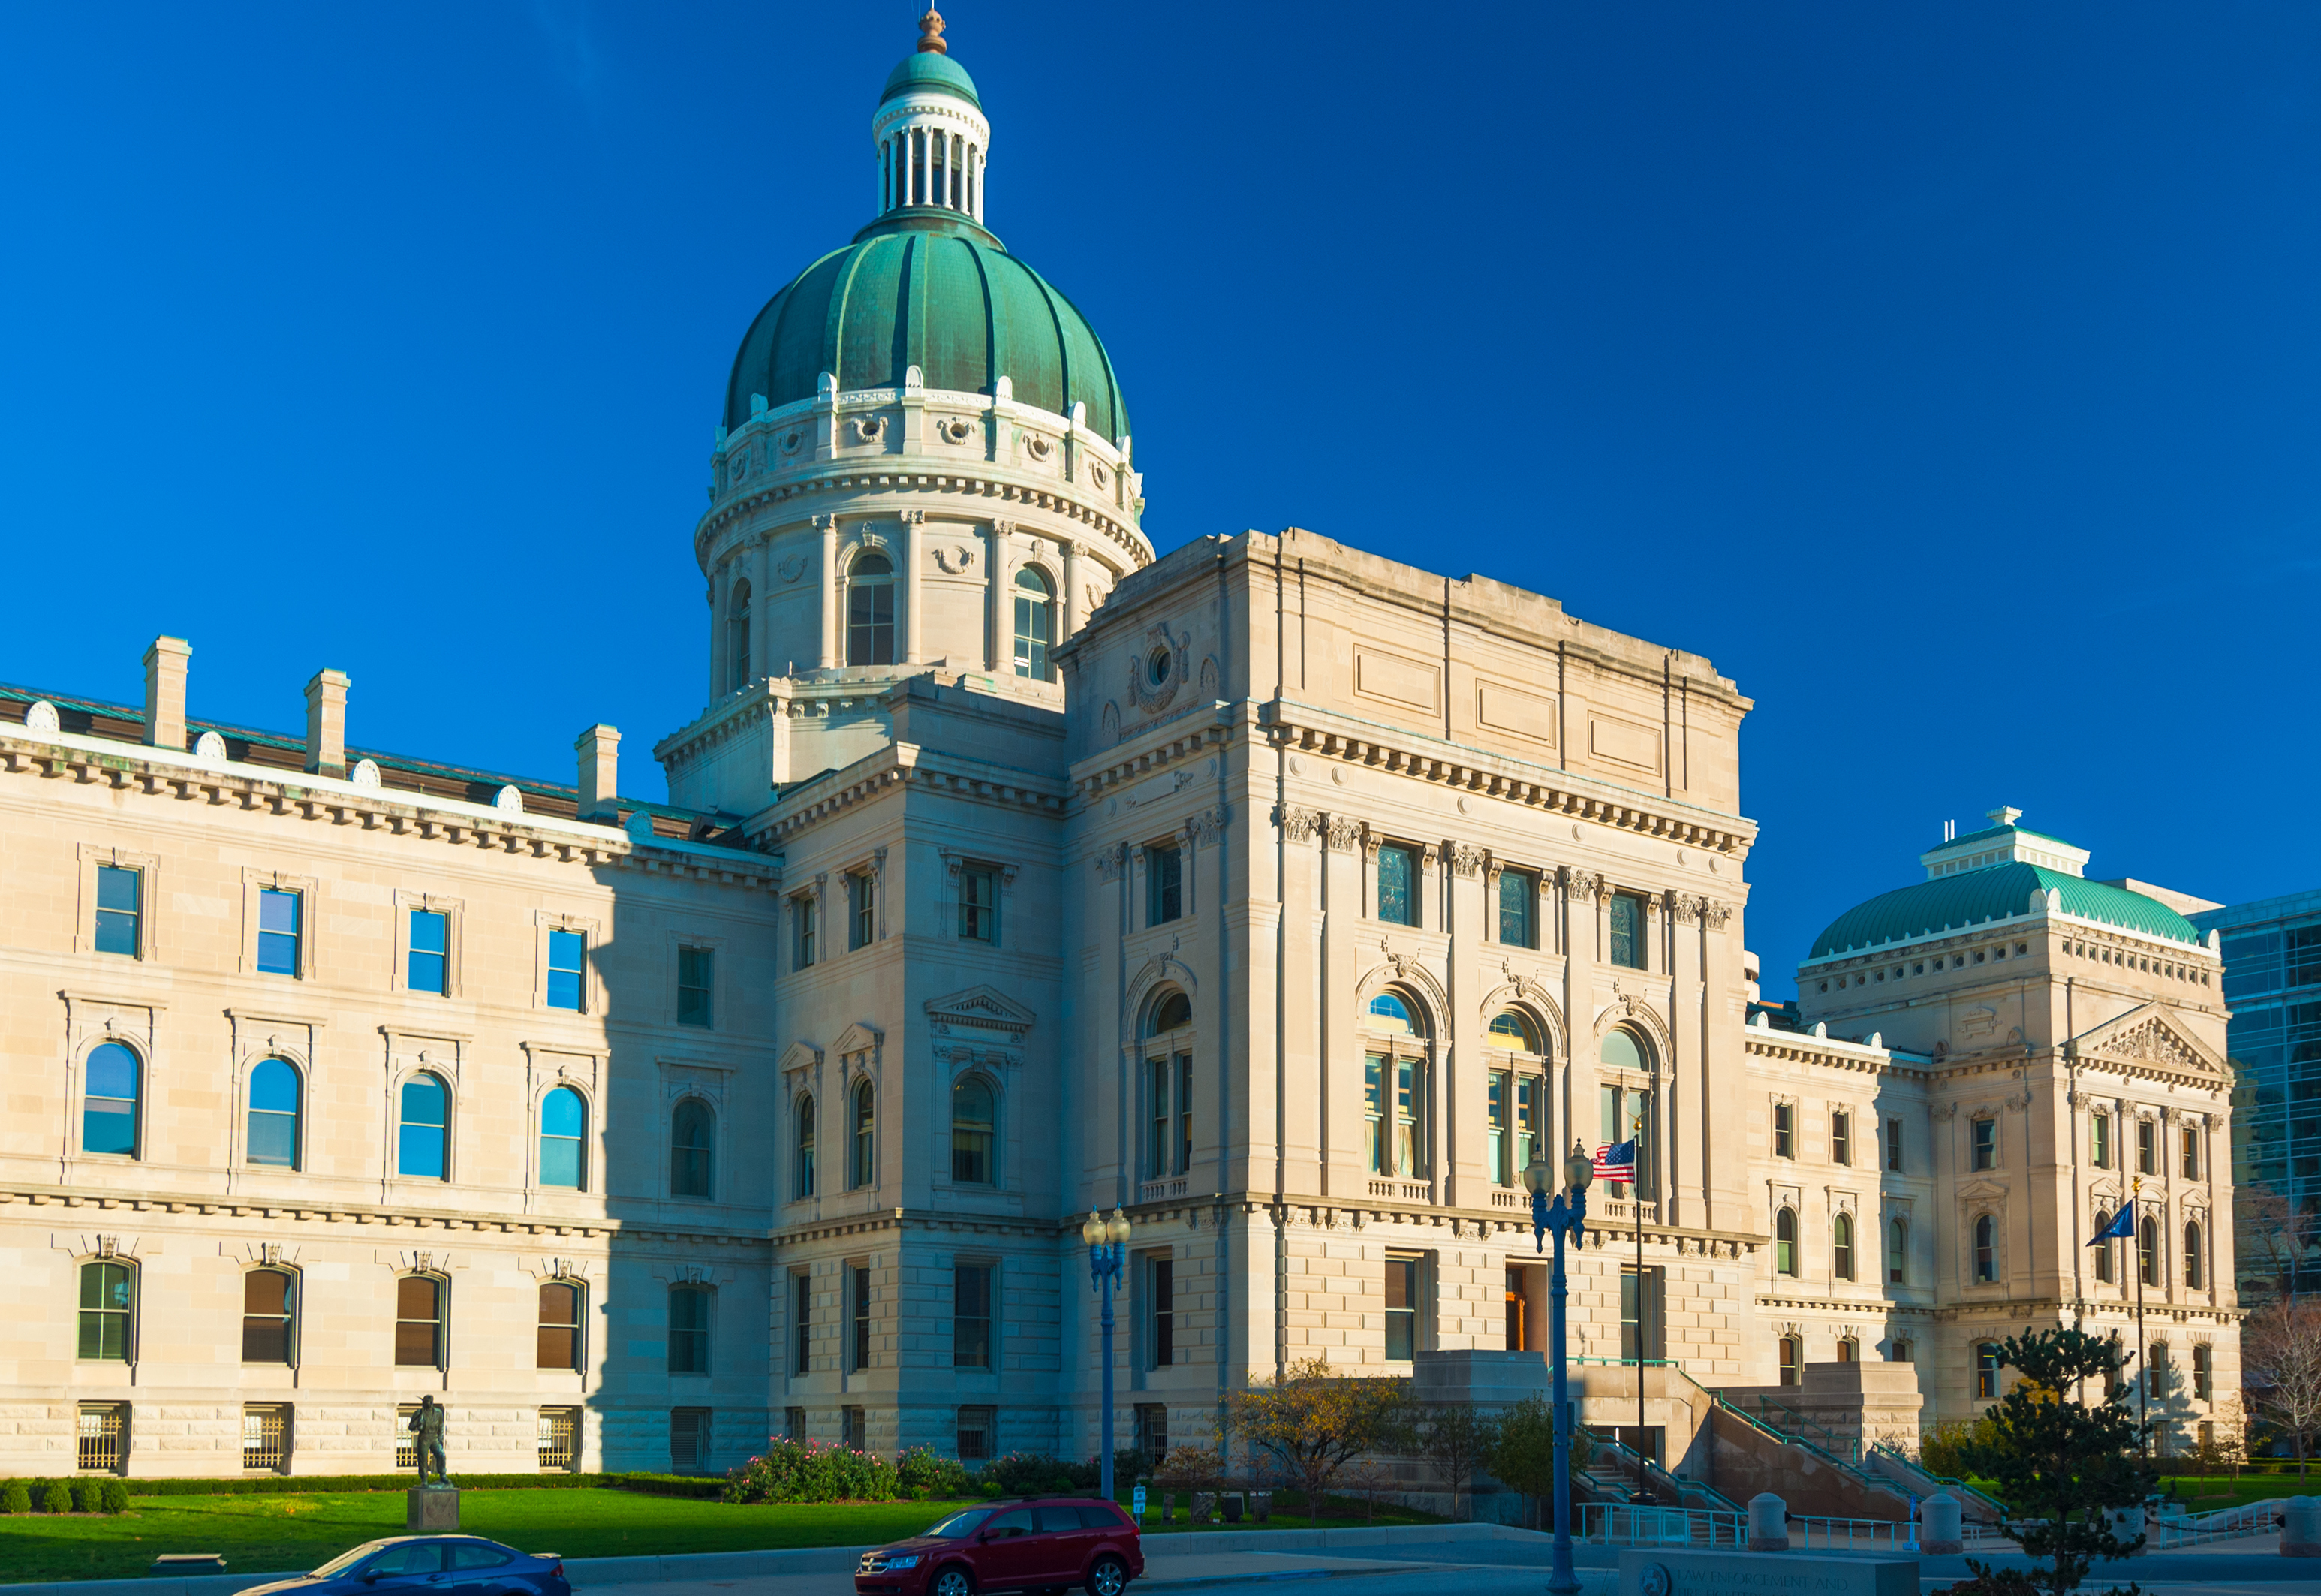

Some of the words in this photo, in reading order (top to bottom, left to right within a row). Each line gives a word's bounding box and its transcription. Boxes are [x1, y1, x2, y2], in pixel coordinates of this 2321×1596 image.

[1678, 1569, 1706, 1582] LAW
[1711, 1570, 1809, 1589] ENFORCEMENT
[1814, 1577, 1848, 1591] AND
